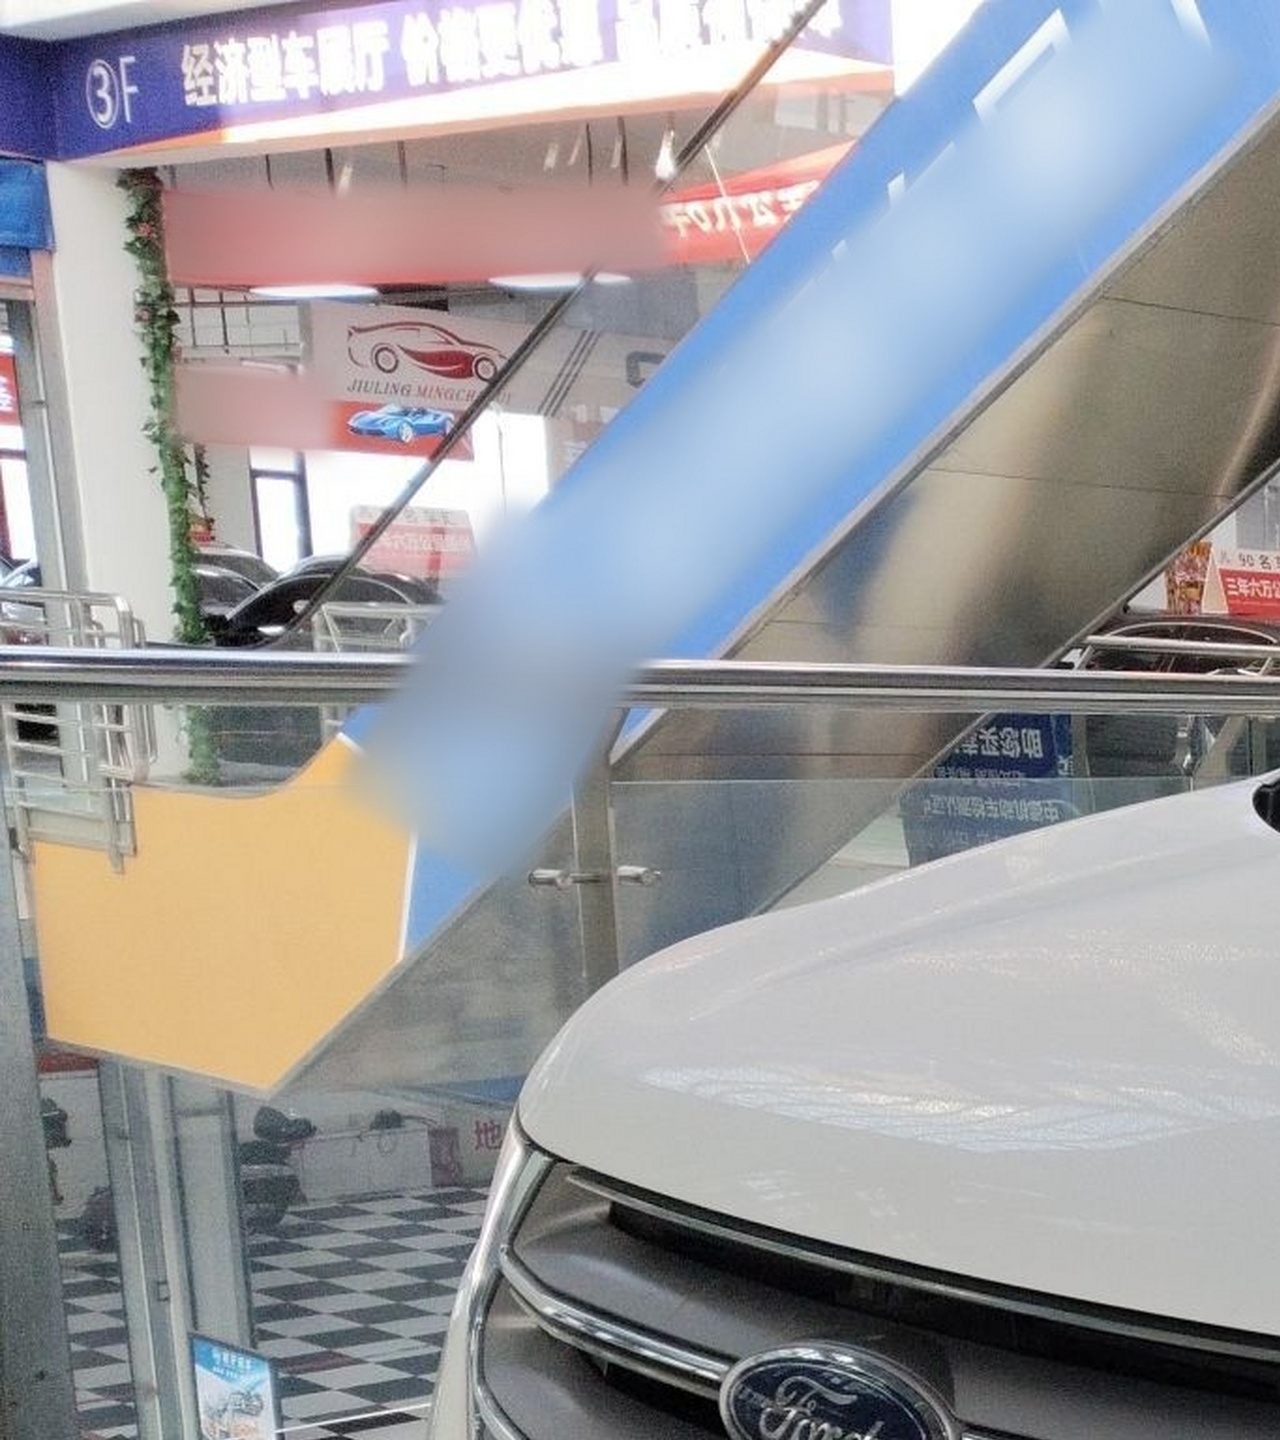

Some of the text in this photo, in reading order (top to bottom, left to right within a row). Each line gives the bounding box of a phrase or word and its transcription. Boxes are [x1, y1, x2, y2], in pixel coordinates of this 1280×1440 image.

[180, 20, 390, 107] 经济型车展厅
